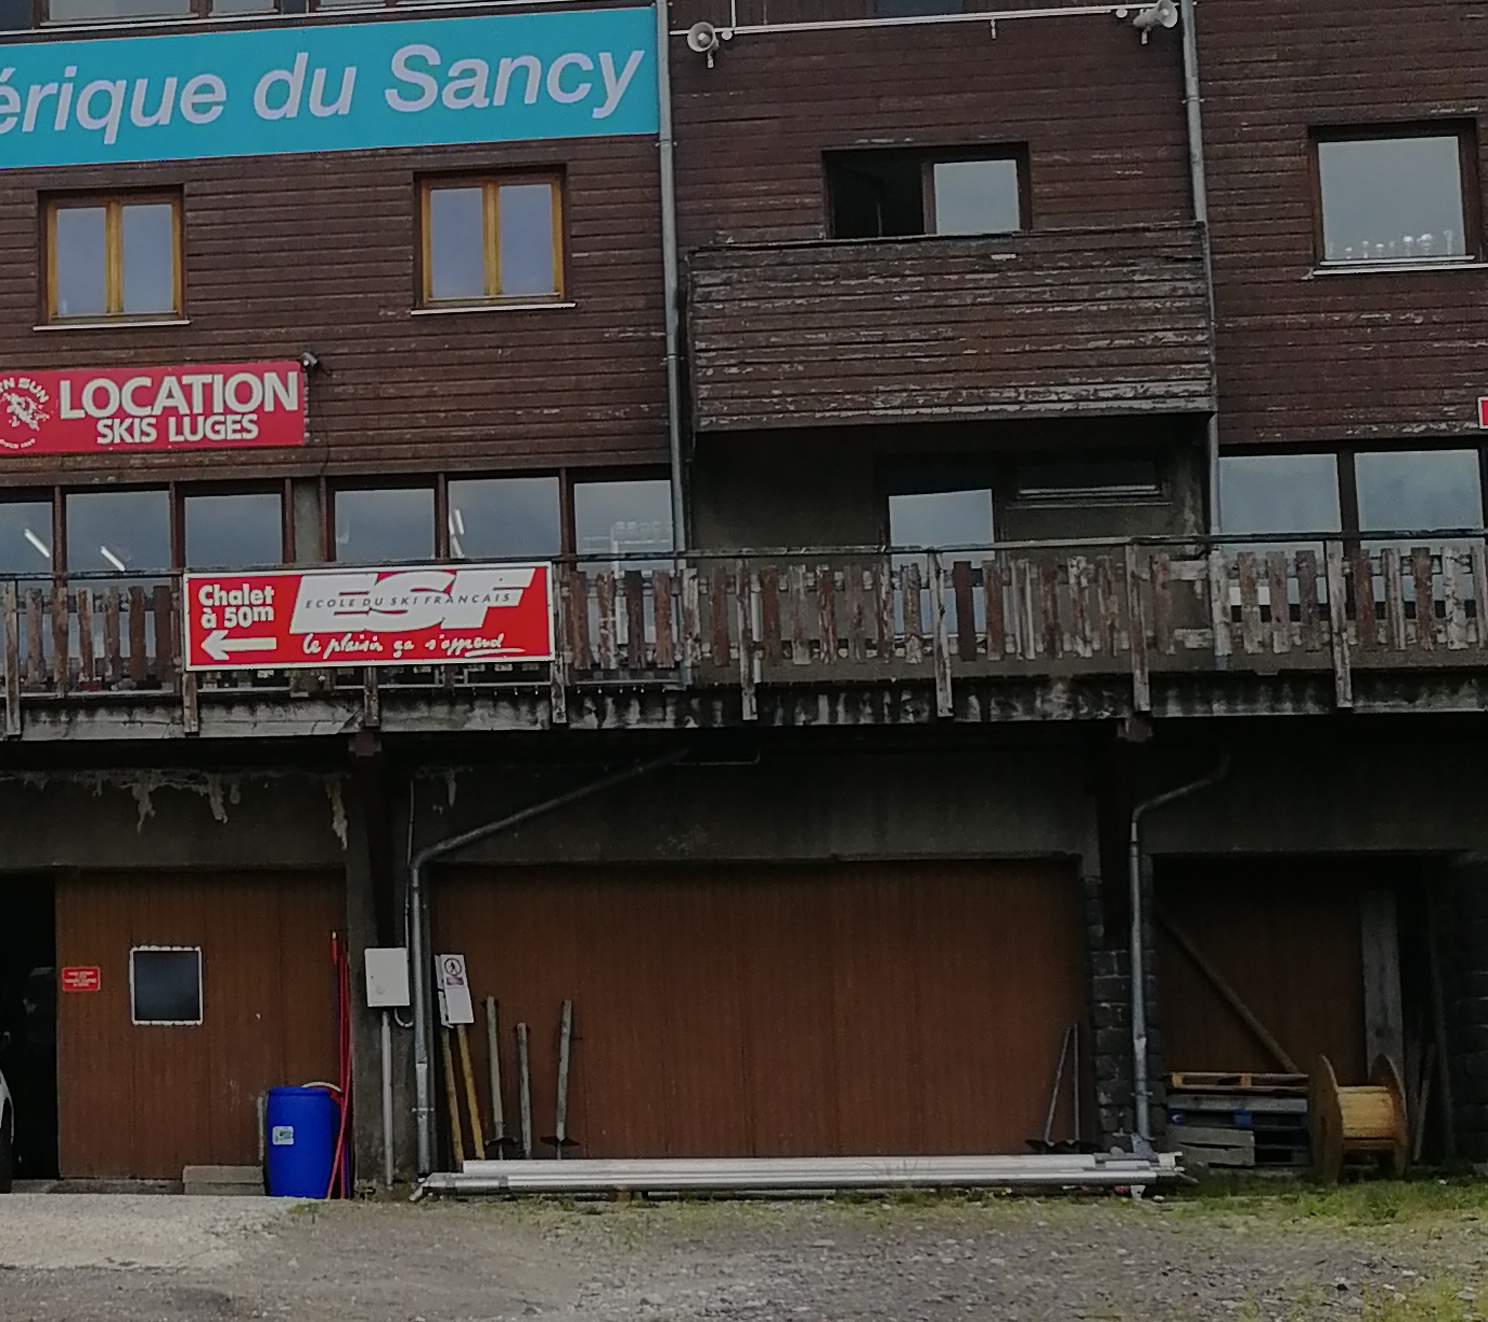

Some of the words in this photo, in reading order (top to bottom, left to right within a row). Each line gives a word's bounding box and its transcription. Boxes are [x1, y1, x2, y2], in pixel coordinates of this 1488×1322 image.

[253, 51, 357, 119] du
[384, 43, 645, 120] Sancy
[18, 377, 50, 403] SUN
[59, 371, 299, 420] LOCATION
[97, 416, 157, 445] SKIS
[168, 413, 259, 443] LUGES
[198, 583, 274, 607] Chalet
[289, 568, 535, 633] ESF
[305, 598, 355, 609] ECOLE
[362, 597, 383, 608] DU
[390, 596, 417, 606] SKI
[424, 593, 510, 606] FRANCAIS
[200, 607, 217, 629] à
[224, 605, 274, 628] 50m
[323, 632, 383, 660] plaisir
